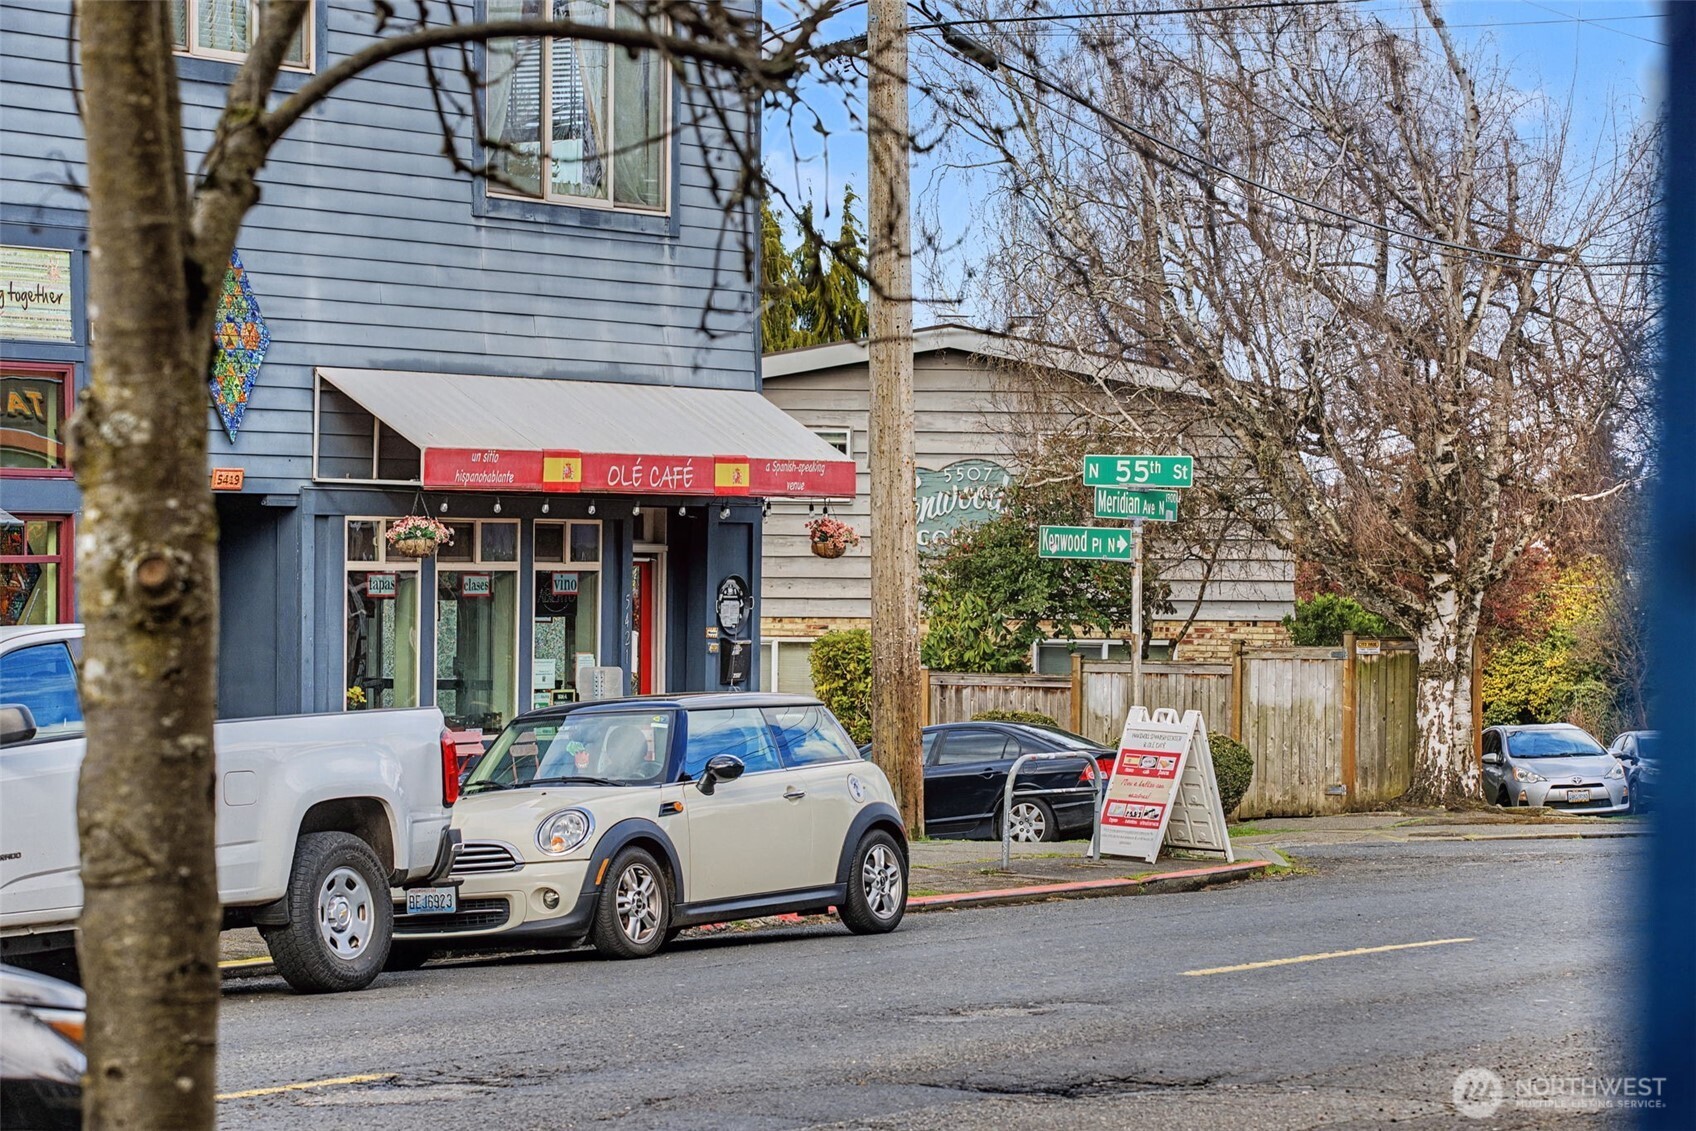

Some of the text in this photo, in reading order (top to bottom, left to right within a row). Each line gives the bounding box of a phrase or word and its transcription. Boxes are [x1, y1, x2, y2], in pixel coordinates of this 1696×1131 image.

[7, 281, 64, 311] together
[471, 449, 500, 463] un sitio
[607, 458, 693, 488] OLÉ CAFÉ
[765, 461, 826, 476] a Spanish-speaking
[944, 467, 993, 482] 5507
[1089, 460, 1188, 482] N 55th St
[454, 469, 515, 486] hispanohablante
[786, 480, 805, 491] venue
[1098, 490, 1140, 513] Meridian
[1142, 499, 1155, 515] Ave
[1159, 500, 1165, 515] N
[1042, 528, 1115, 552] Kenwood Pl N
[369, 577, 395, 593] tapas
[463, 578, 489, 591] clases
[554, 574, 577, 591] vino
